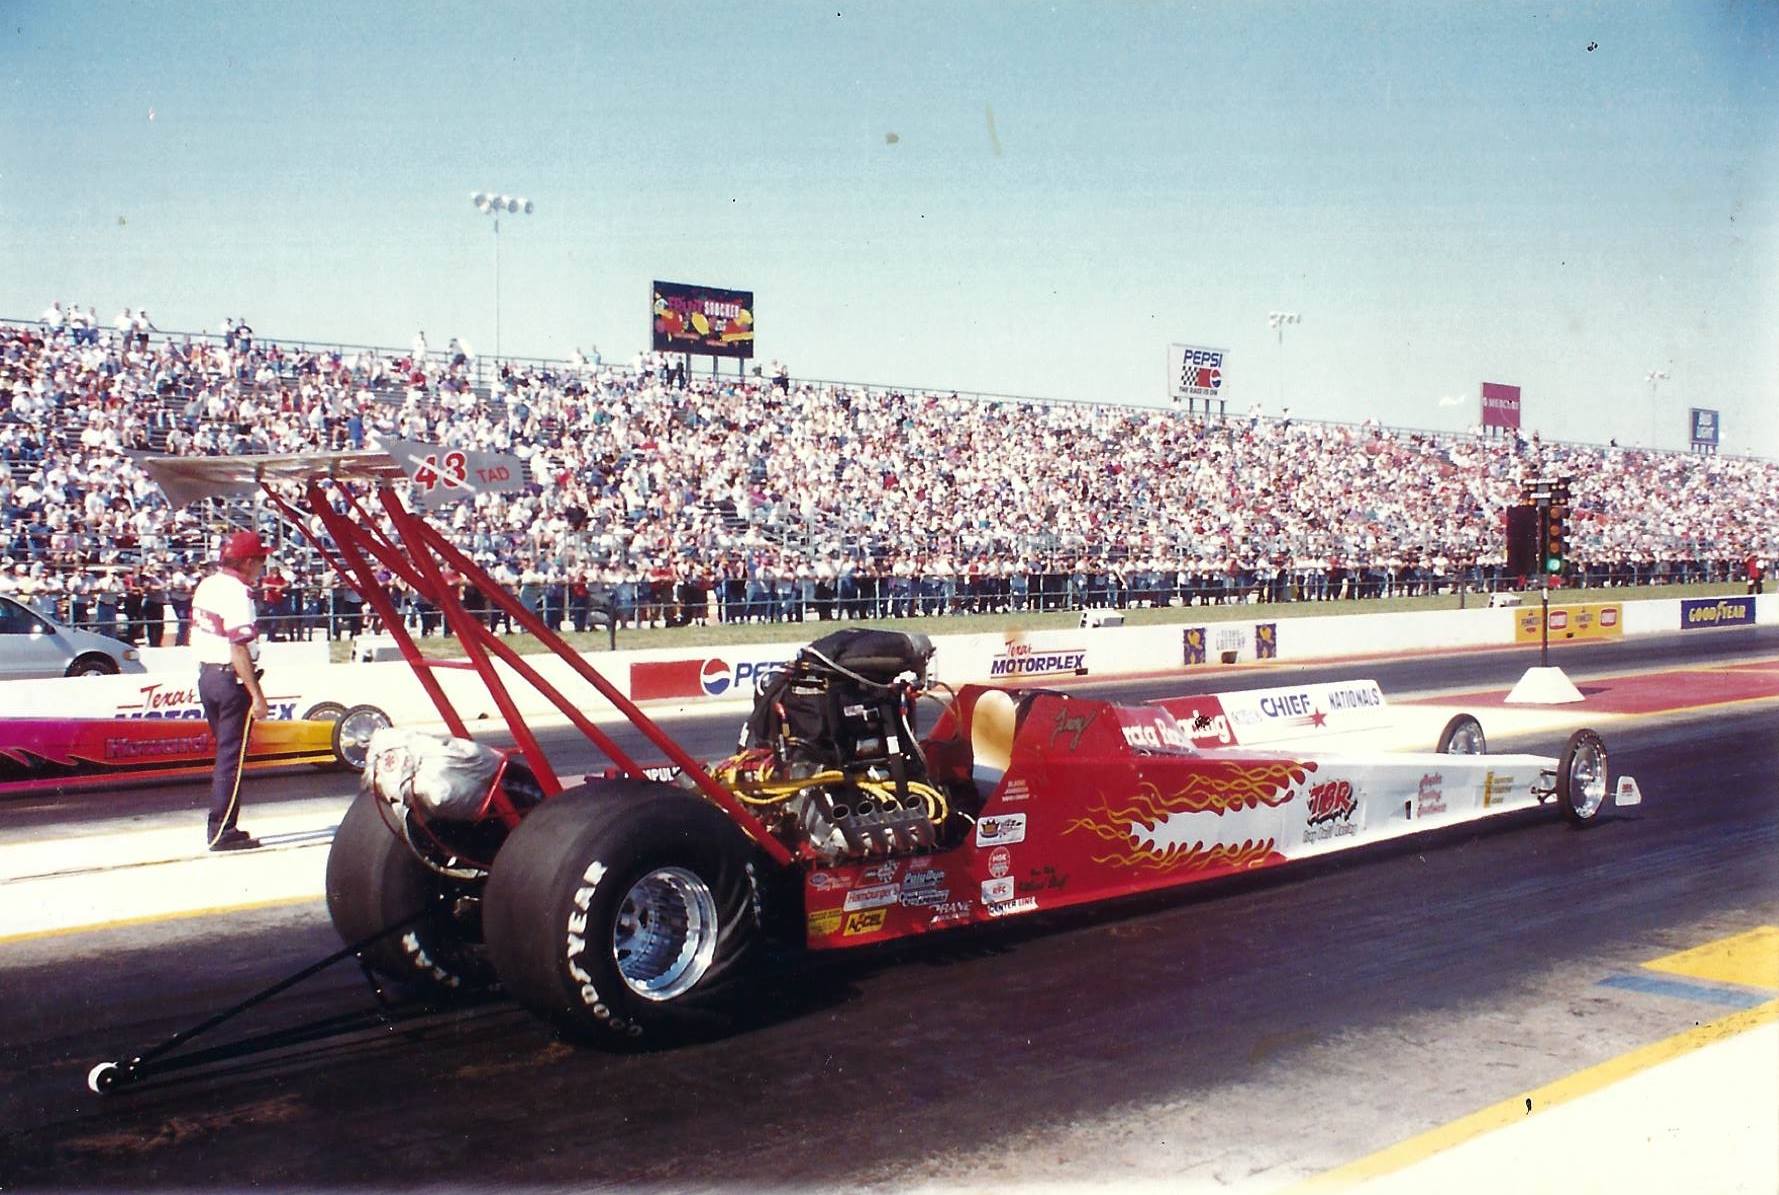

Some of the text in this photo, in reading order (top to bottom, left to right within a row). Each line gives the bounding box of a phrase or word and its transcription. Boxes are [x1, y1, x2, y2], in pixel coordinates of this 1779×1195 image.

[1183, 350, 1223, 367] PEPSI
[990, 654, 1085, 675] MOTORPLEX
[140, 684, 196, 711] Texas
[1260, 693, 1311, 718] CHIEF
[1327, 687, 1381, 711] NATIONALS
[1308, 779, 1353, 820] TBR
